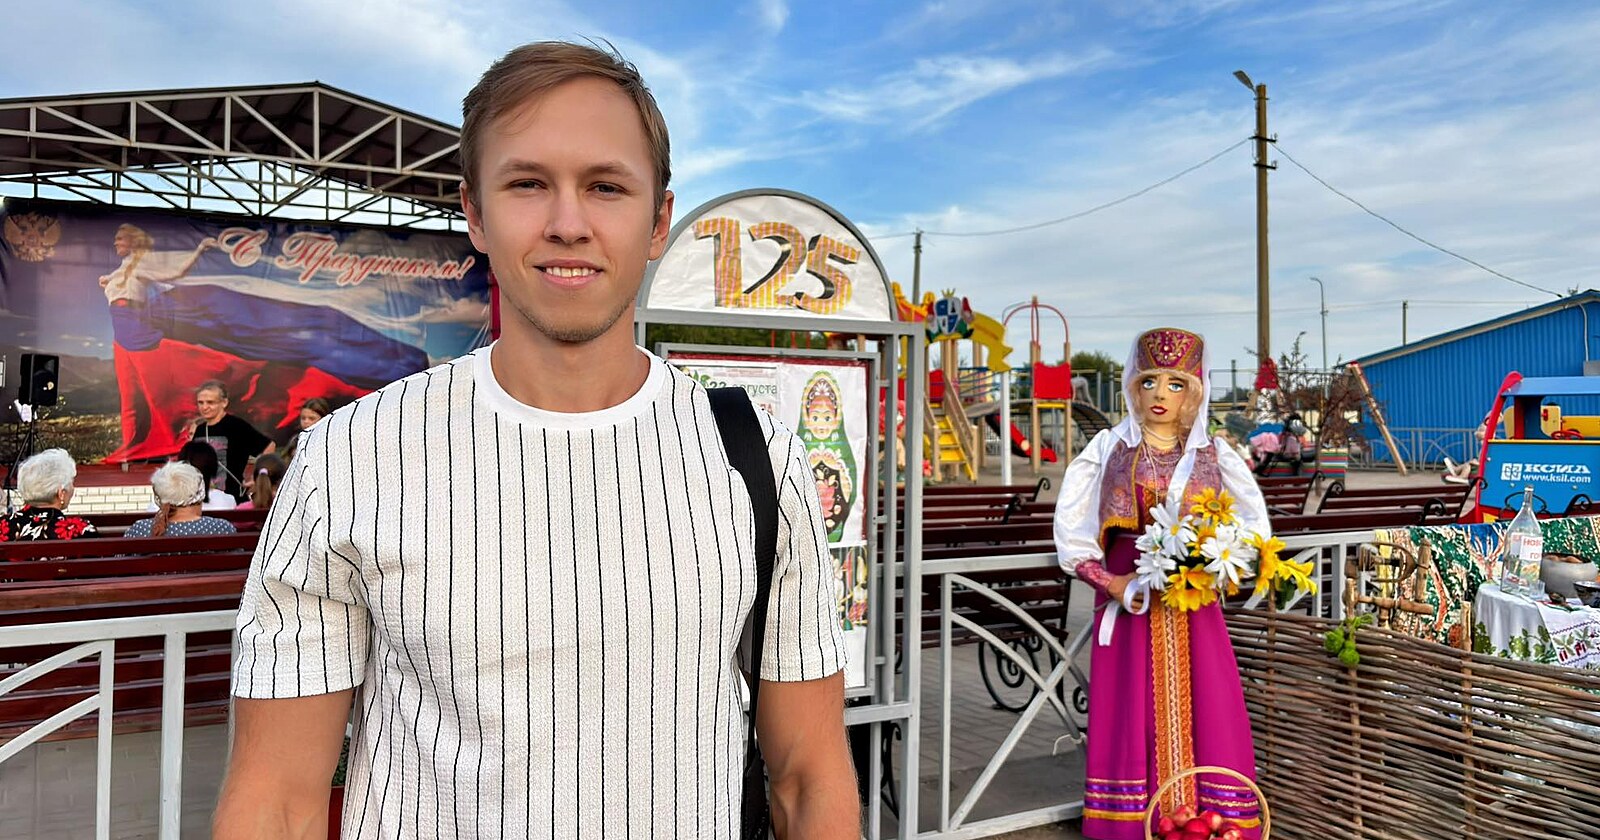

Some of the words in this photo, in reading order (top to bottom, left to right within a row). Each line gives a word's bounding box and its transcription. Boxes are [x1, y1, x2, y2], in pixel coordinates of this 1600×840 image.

[218, 227, 269, 268] С
[274, 231, 475, 286] Праздником!
[692, 216, 861, 315] 125
[1522, 474, 1591, 483] www.ksil.com
